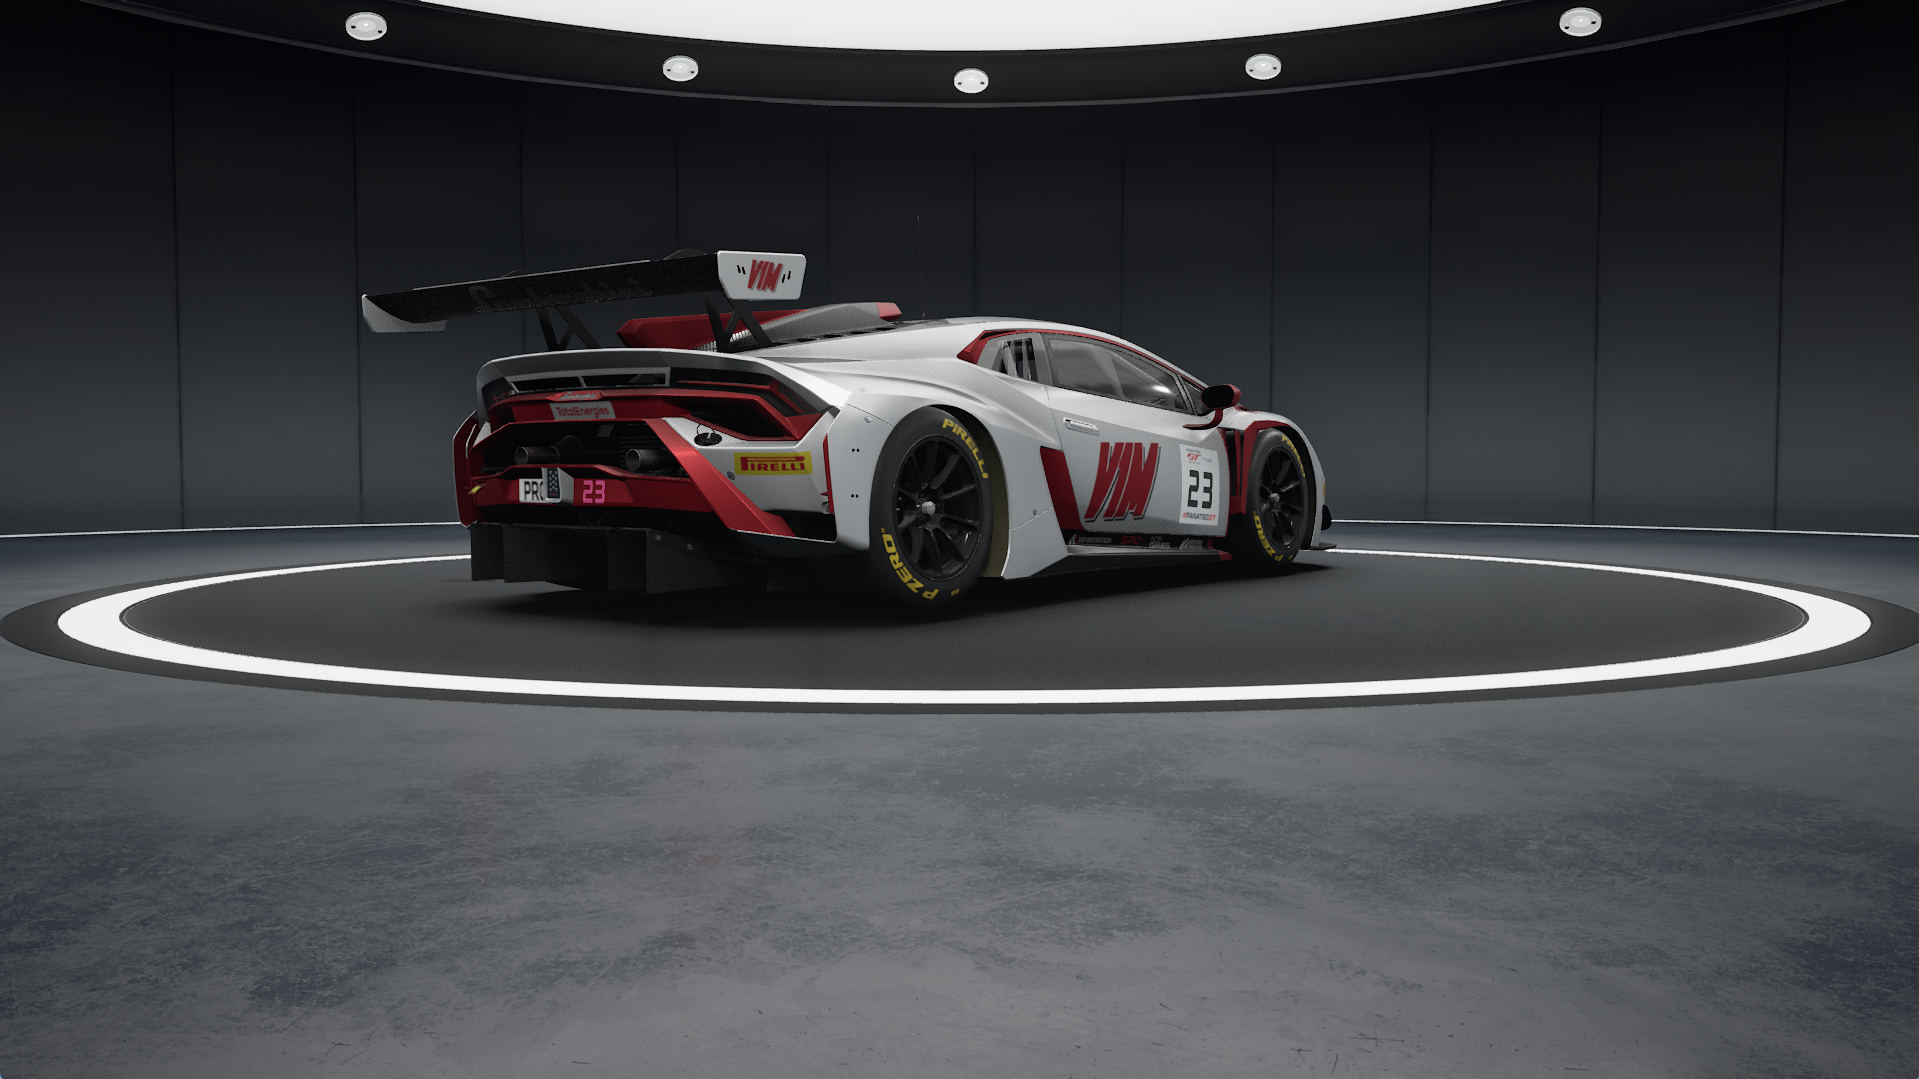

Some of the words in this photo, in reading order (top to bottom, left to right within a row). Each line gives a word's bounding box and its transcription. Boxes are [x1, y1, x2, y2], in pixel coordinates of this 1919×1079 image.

[748, 259, 783, 292] VIM
[555, 405, 610, 418] TotalEnergies
[740, 455, 806, 472] PIRELLI
[941, 417, 989, 479] PIRELLI
[582, 479, 606, 504] 23
[1084, 441, 1161, 522] VIM
[1187, 470, 1213, 509] 23
[1120, 535, 1142, 545] SRO
[1253, 514, 1276, 557] ZERO
[882, 533, 924, 594] ZERO
[922, 588, 940, 601] P
